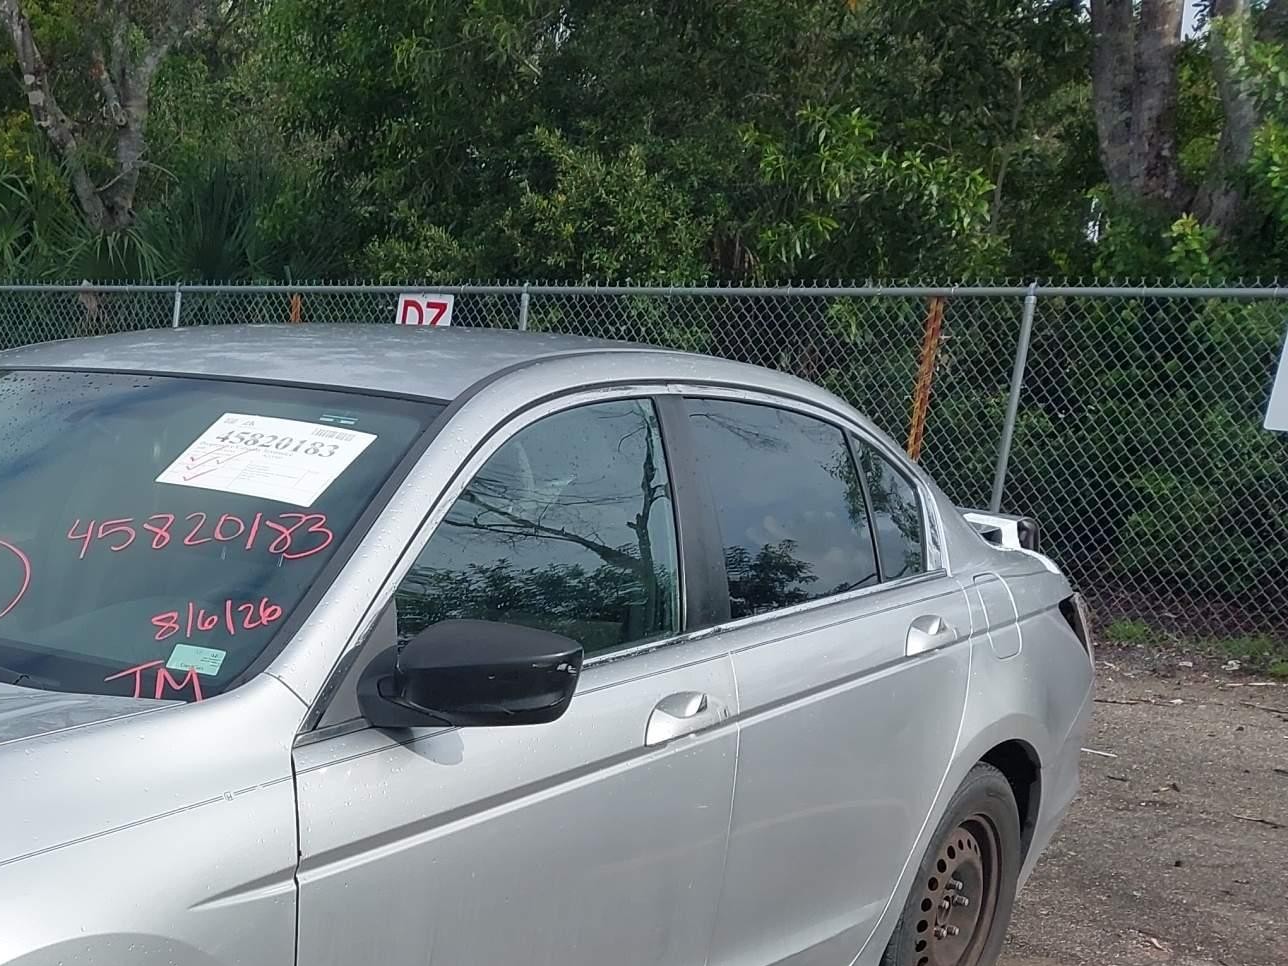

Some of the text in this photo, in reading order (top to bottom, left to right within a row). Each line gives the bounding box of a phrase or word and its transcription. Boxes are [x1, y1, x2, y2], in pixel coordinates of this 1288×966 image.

[216, 430, 340, 458] 45820183
[67, 512, 333, 559] 45820183
[151, 598, 283, 640] 8/6/26
[104, 660, 202, 702] TM
